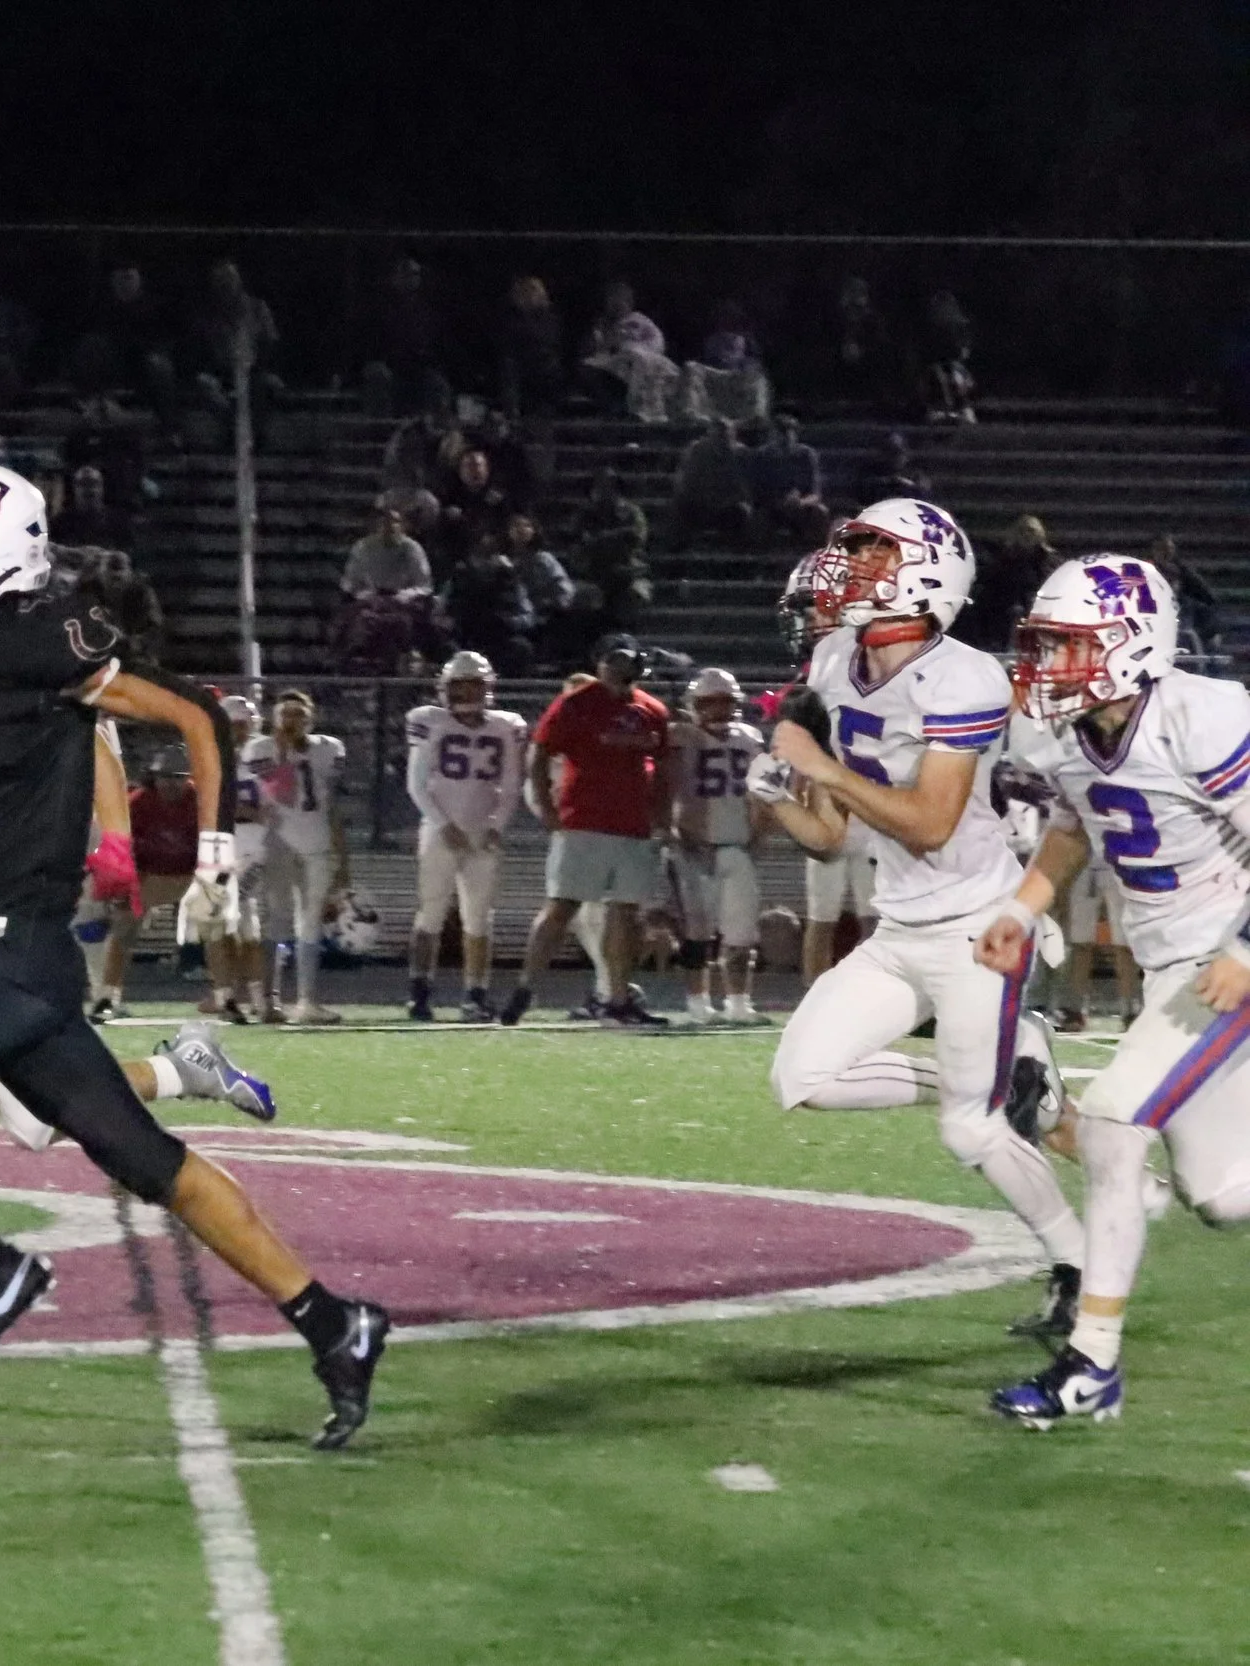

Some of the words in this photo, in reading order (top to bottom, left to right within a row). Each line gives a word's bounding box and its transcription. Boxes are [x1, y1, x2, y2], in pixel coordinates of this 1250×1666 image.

[439, 733, 504, 781] 63
[837, 705, 893, 788] 5
[1086, 781, 1180, 892] 2
[184, 1048, 219, 1073] NIKE
